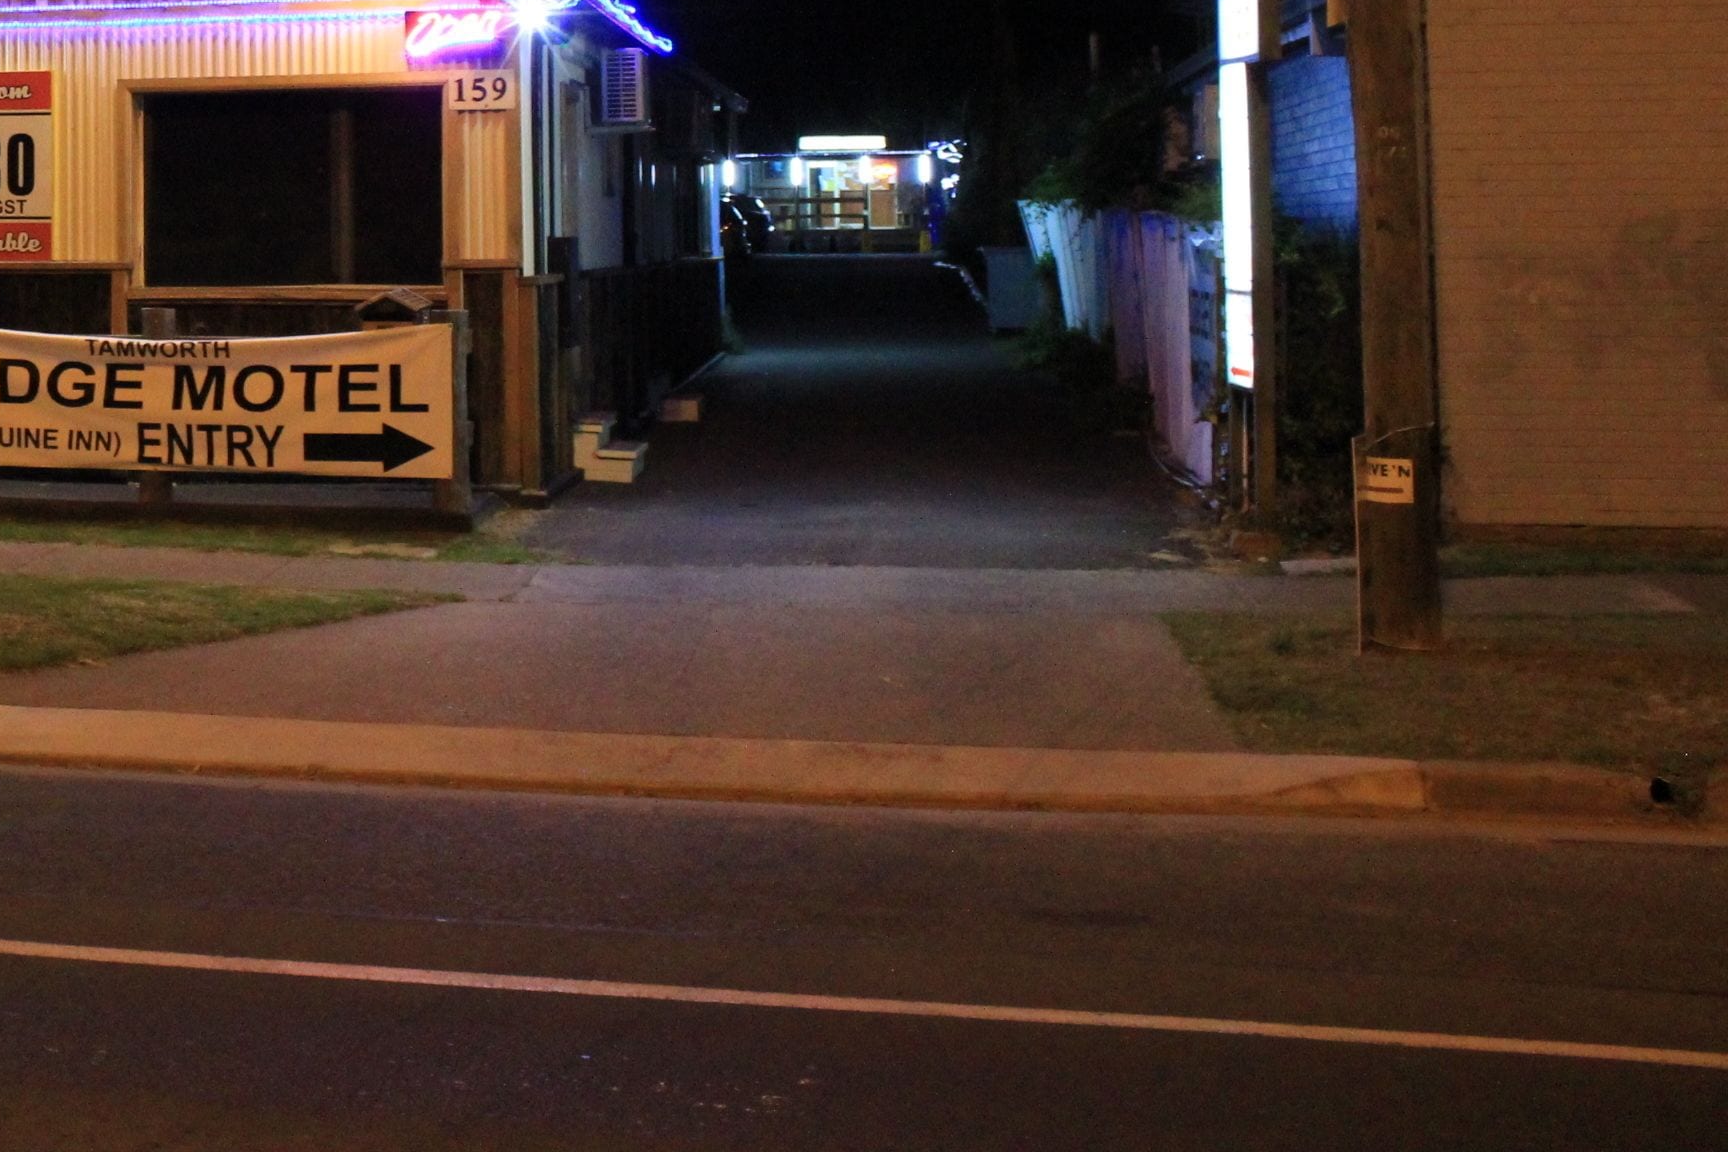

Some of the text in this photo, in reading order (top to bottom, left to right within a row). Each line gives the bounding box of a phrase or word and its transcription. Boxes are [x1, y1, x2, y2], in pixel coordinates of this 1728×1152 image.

[453, 77, 508, 103] 159
[85, 339, 231, 359] TAMWORTH
[172, 364, 430, 413] MOTEL
[68, 429, 121, 457] INN)
[137, 422, 285, 468] ENTRY
